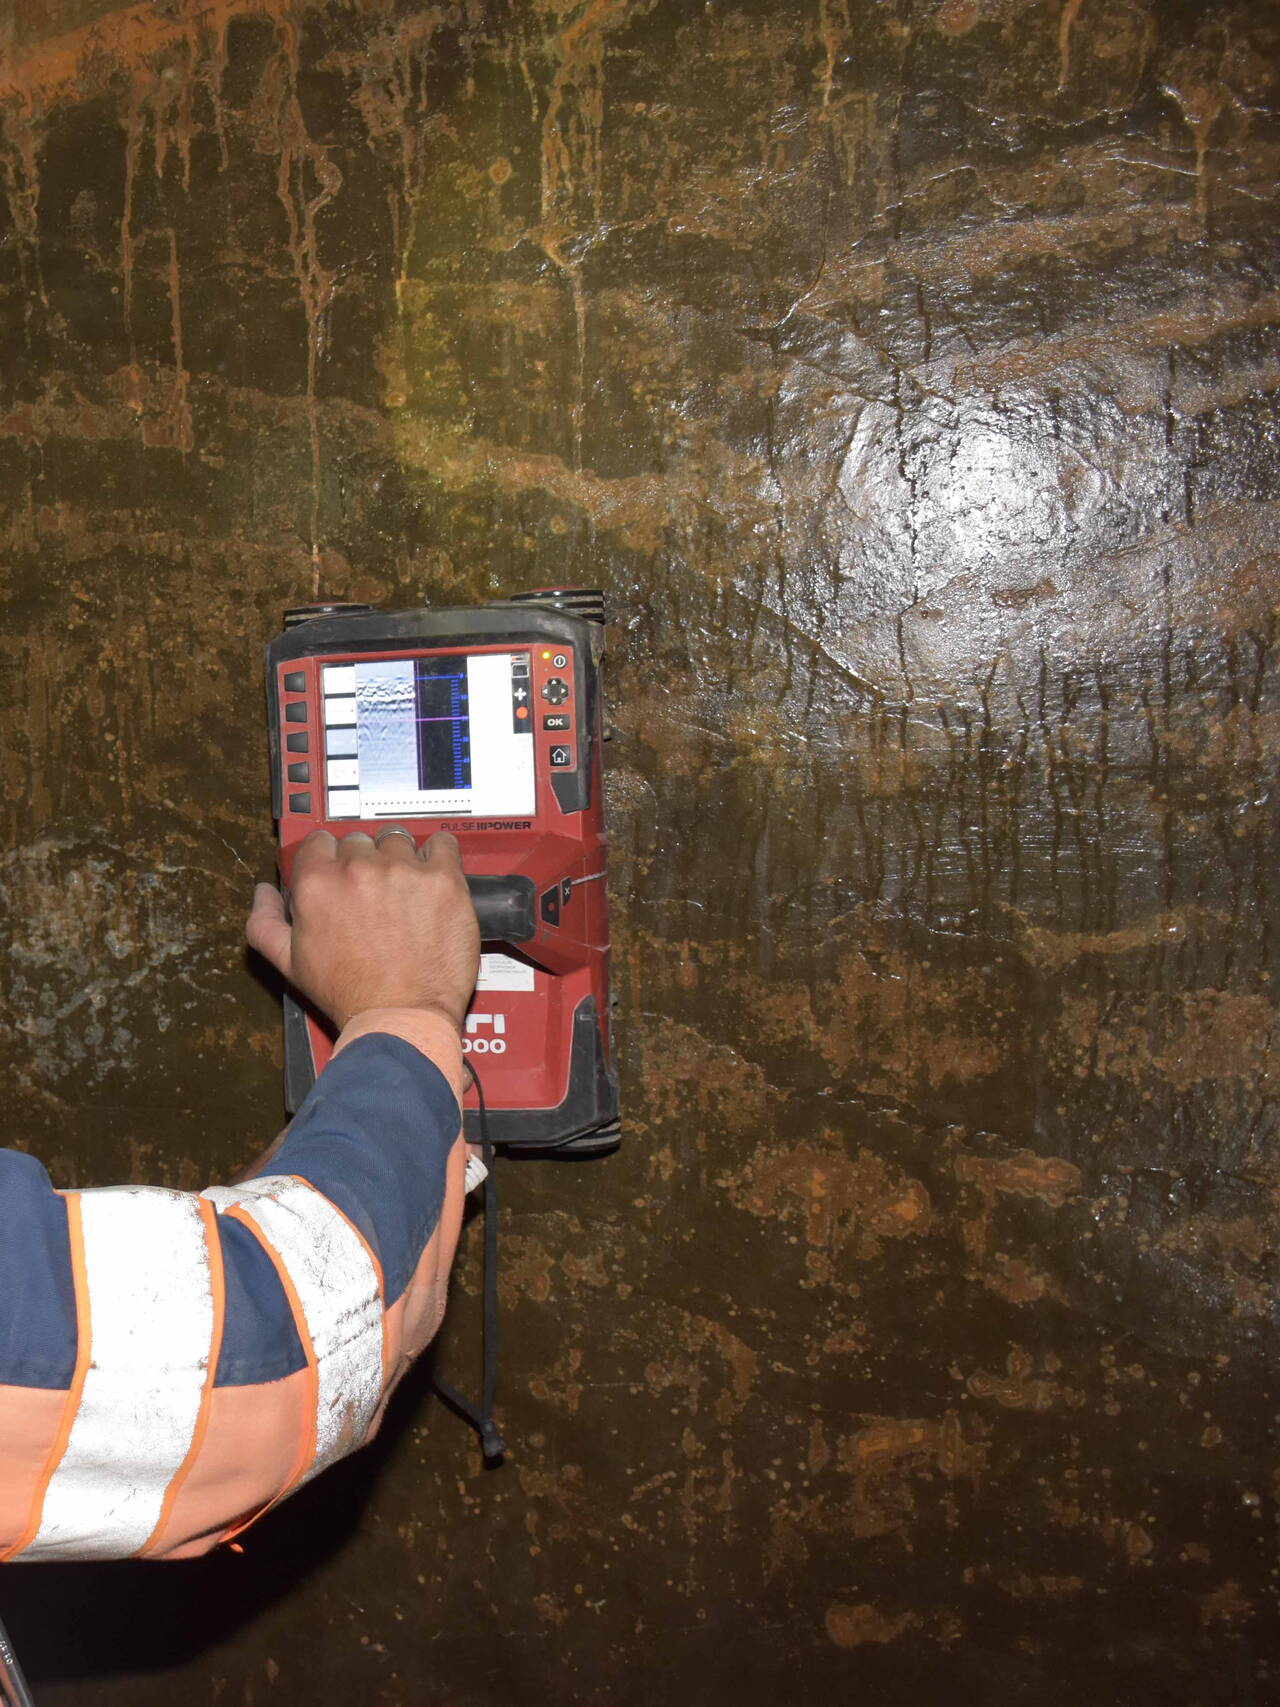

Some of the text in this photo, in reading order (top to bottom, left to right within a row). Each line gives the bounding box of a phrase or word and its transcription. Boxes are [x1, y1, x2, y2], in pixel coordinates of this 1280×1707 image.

[547, 718, 564, 726] OK
[441, 821, 531, 831] PULSE POWER
[461, 1038, 507, 1054] 000
